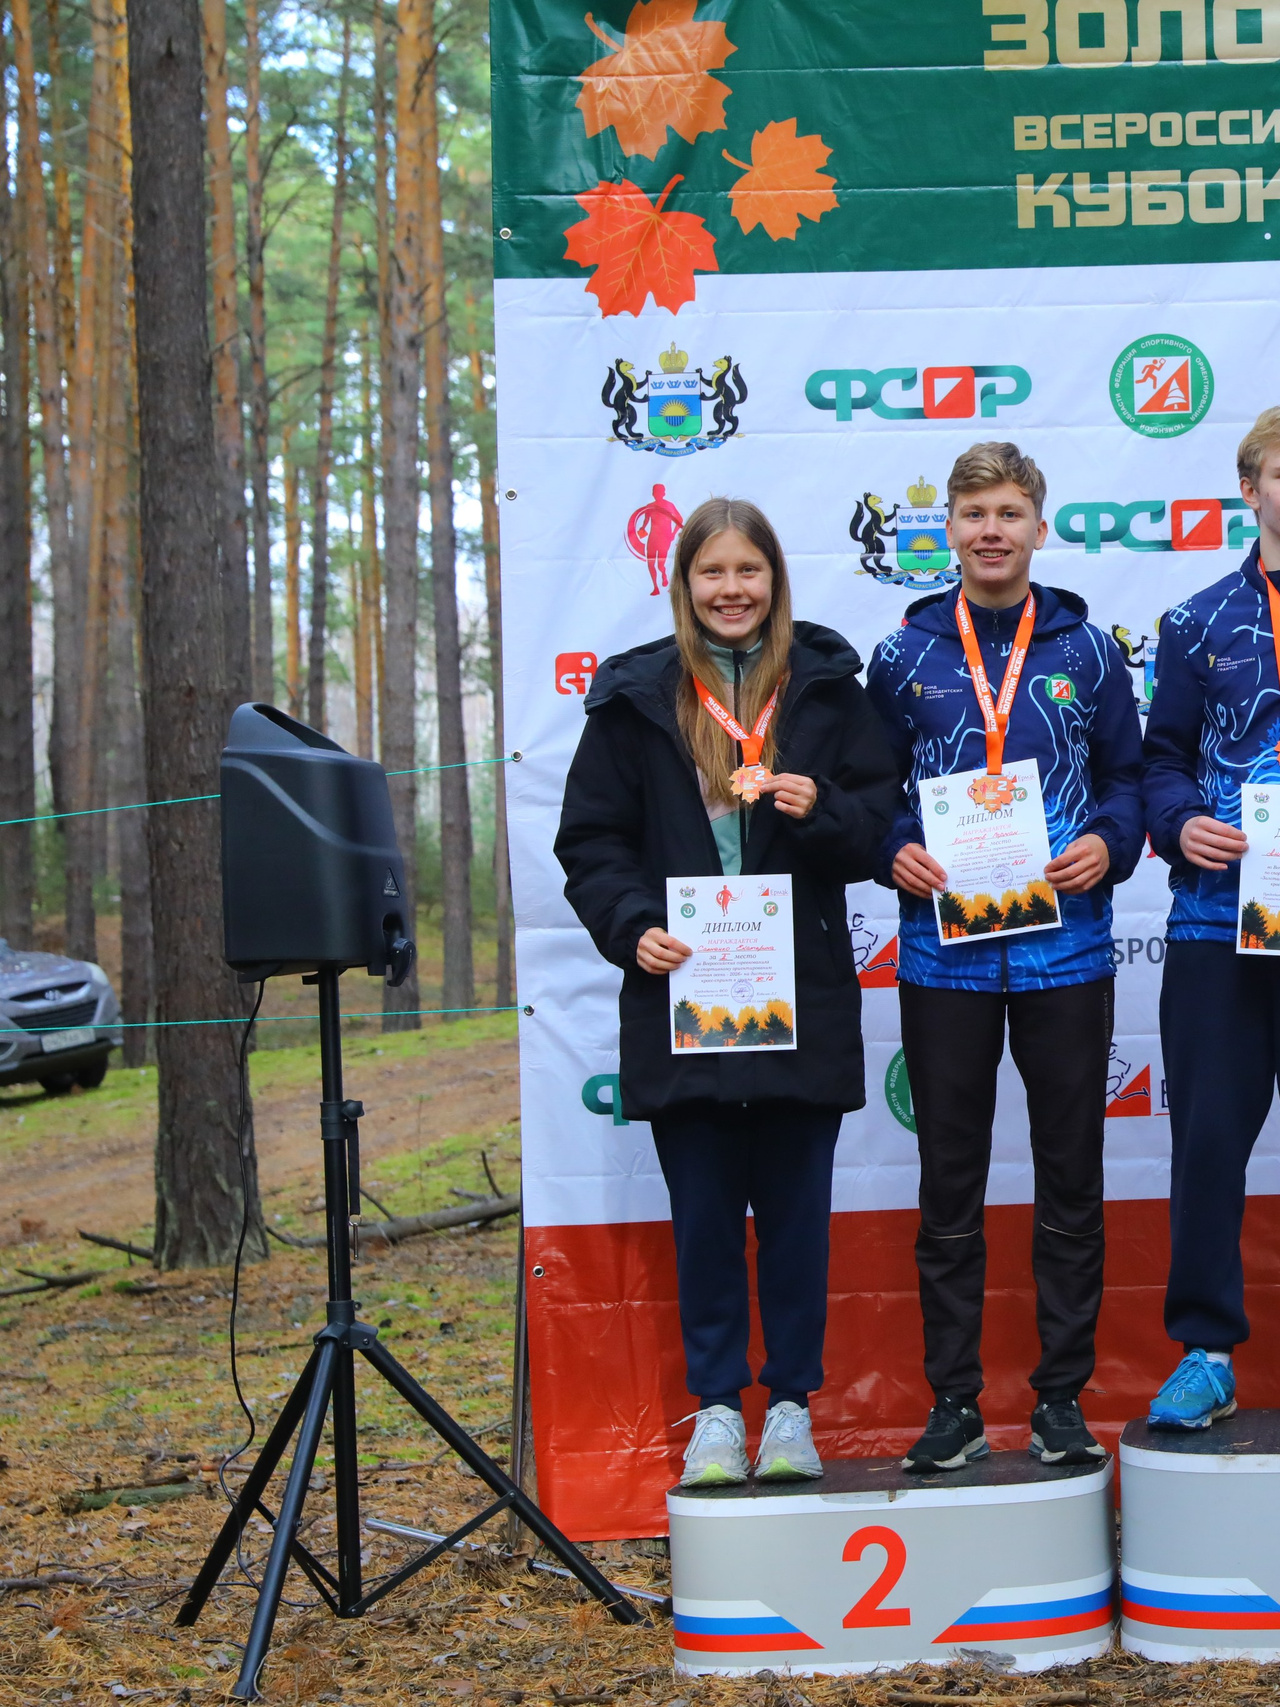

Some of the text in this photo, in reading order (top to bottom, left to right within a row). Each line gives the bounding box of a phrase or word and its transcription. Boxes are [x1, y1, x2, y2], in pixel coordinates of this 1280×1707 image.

[1141, 339, 1192, 354] СПОРТИВНОГО
[1115, 349, 1137, 388] ФЕДЕРАЦИЯ
[1115, 393, 1135, 423] ОБЛАСТИ
[1002, 648, 1025, 714] ЗОЛОТАЯ ОСЕНЬ
[983, 694, 997, 732] ЗОЛОТАЯ
[755, 770, 765, 781] 2
[997, 780, 1007, 791] 2
[957, 808, 1013, 827] ДИПЛОМ
[702, 922, 761, 934] ДИПЛОМ
[890, 1054, 911, 1122] ФЕДЕРАЦ ОБЛАСТИ
[843, 1526, 910, 1629] 2
